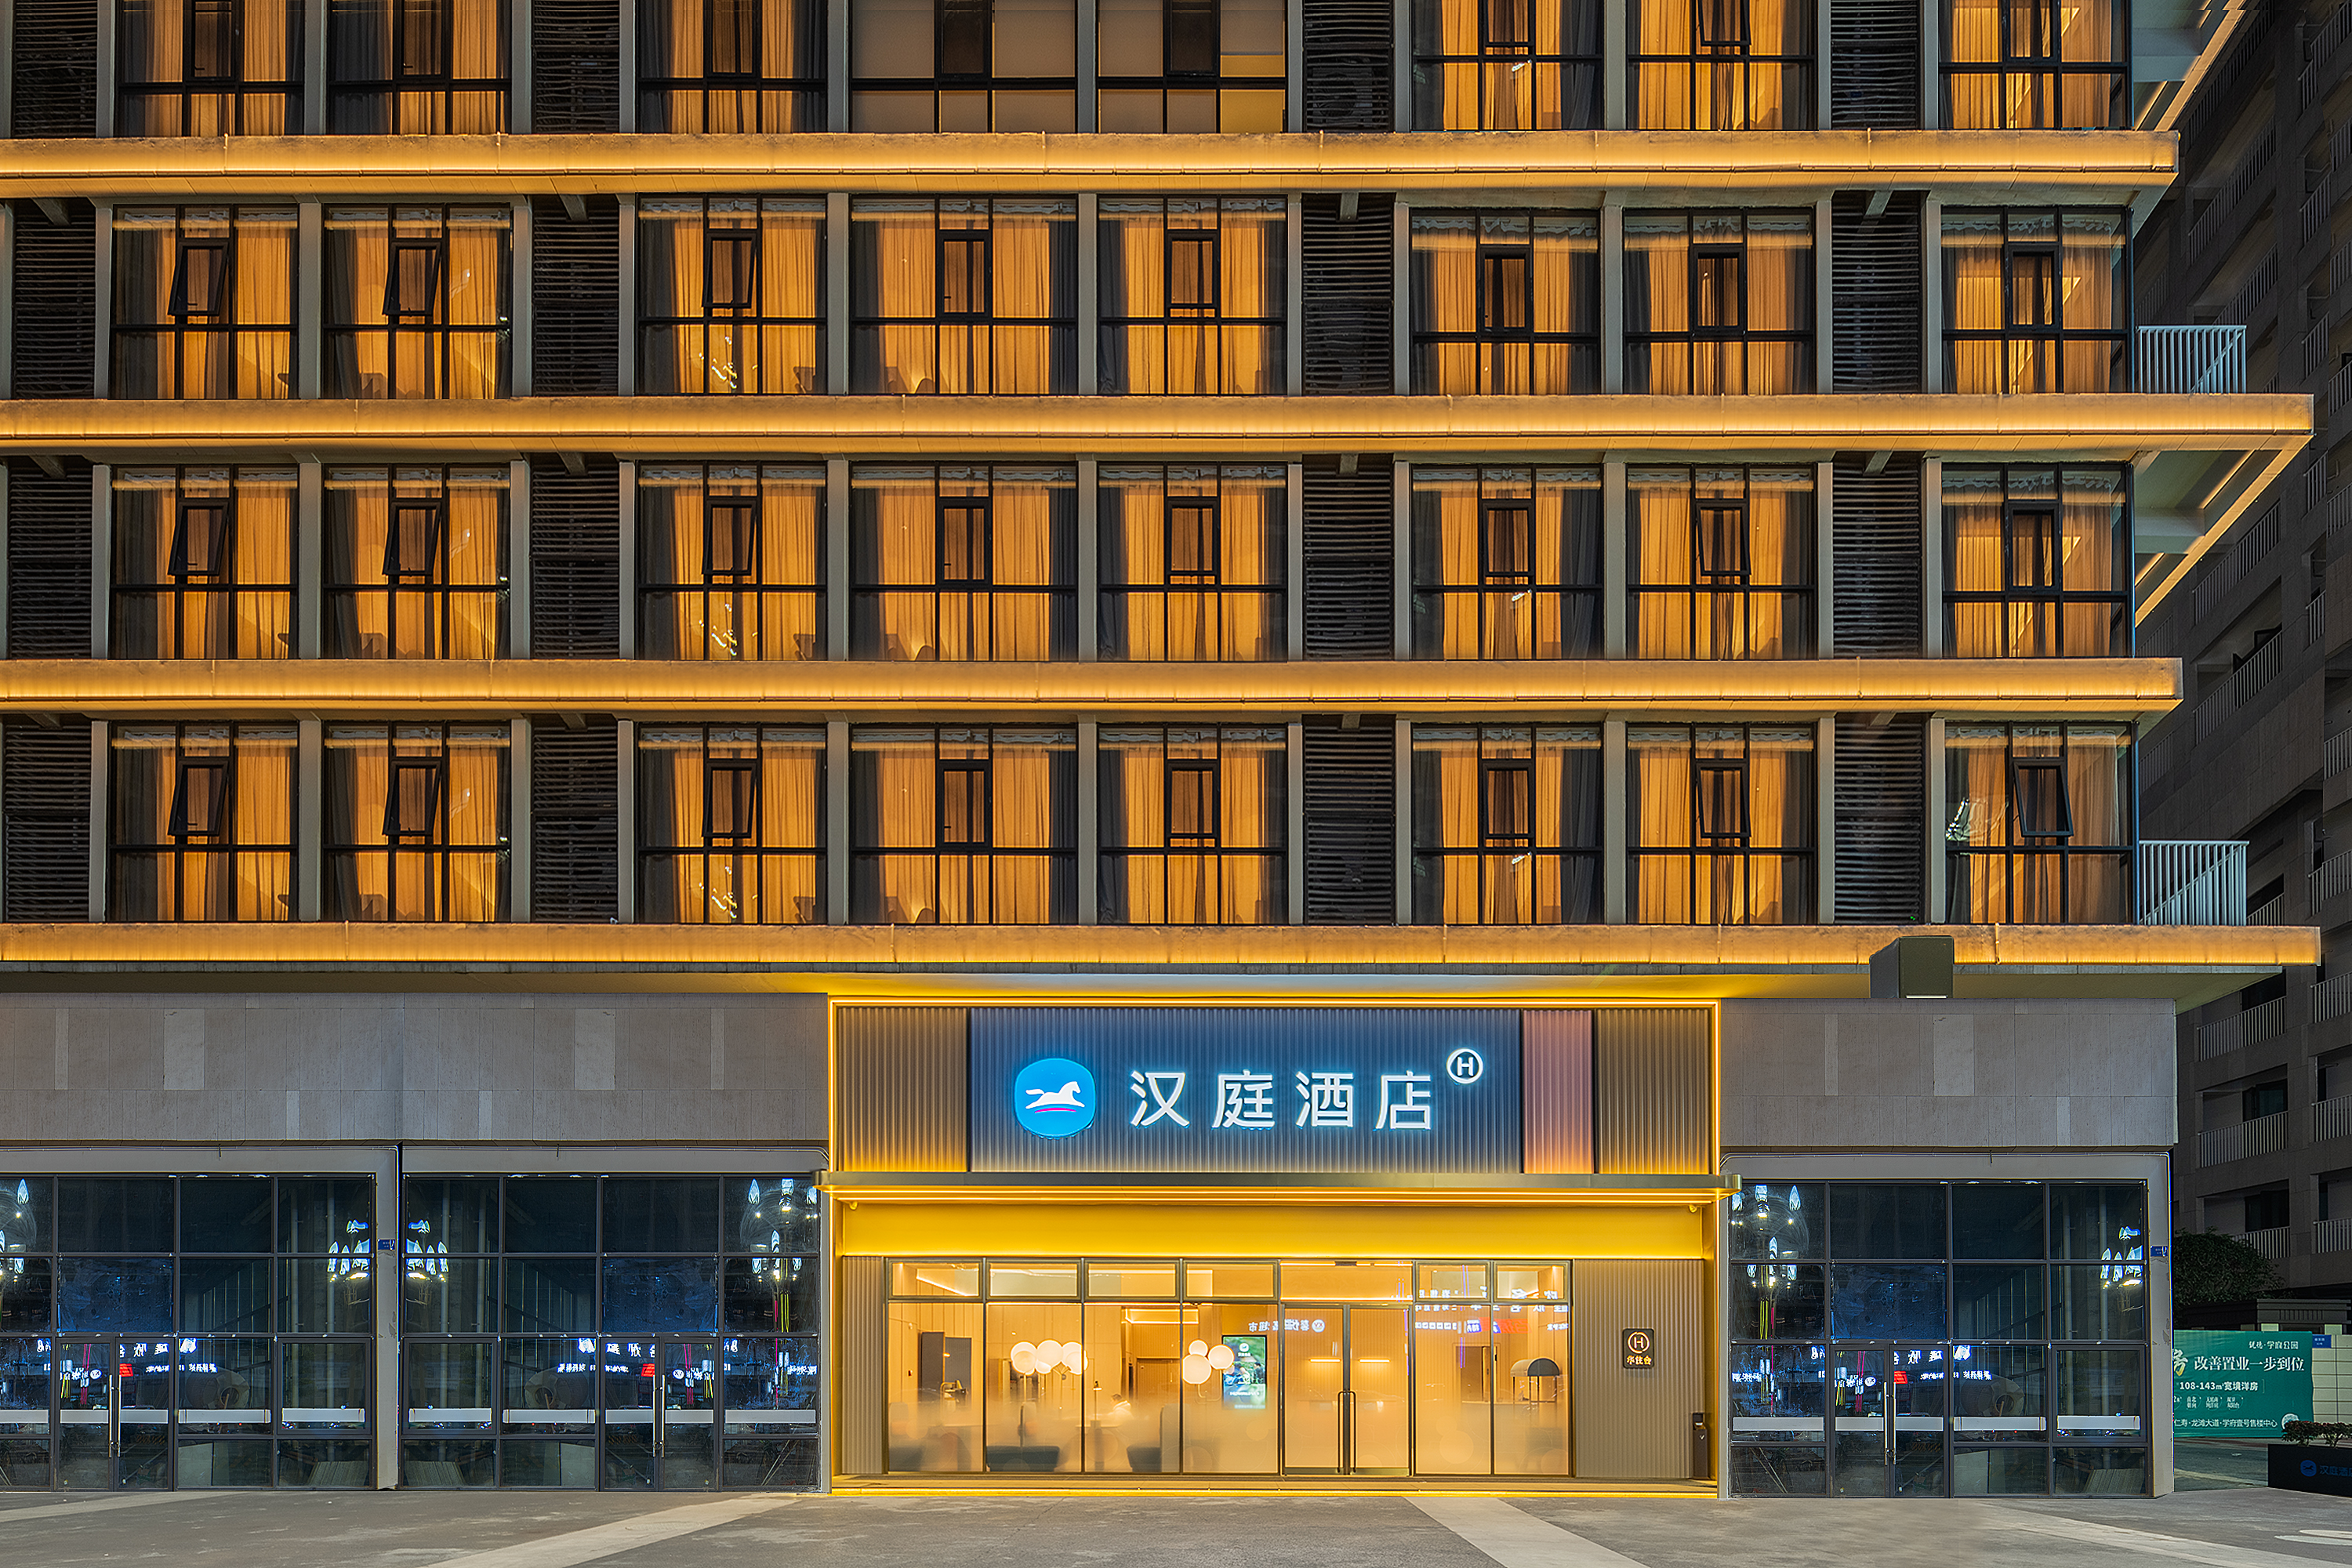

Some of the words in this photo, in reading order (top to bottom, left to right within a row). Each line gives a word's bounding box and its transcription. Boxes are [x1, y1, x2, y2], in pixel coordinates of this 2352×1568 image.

[1130, 1069, 1432, 1131] 汉庭酒店
[2194, 1356, 2305, 1372] 改善置业一步到位
